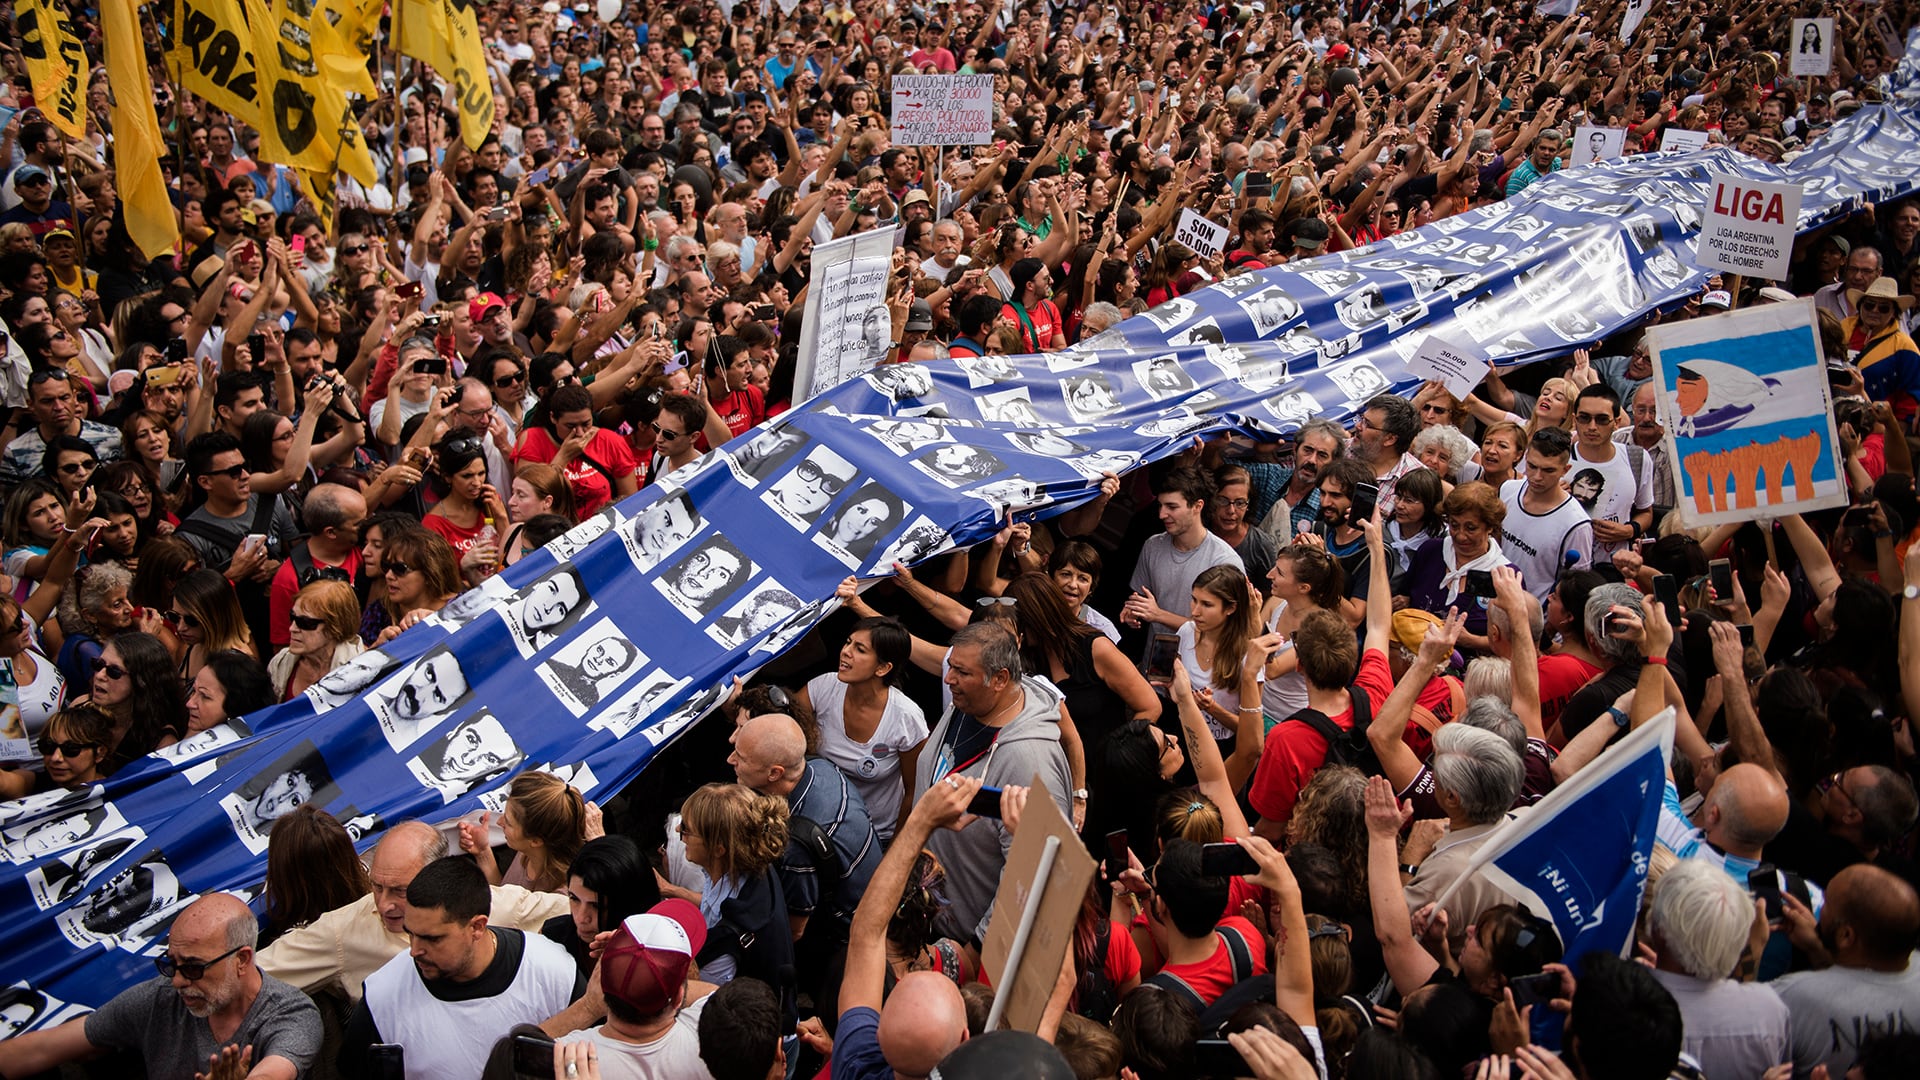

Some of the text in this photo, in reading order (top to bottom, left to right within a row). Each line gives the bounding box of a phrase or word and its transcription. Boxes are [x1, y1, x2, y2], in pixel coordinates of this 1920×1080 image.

[444, 5, 467, 38] OPULAR
[913, 89, 930, 99] POR
[931, 89, 946, 99] LOS
[924, 100, 963, 110] POR LOS
[897, 110, 933, 122] PRESOS
[904, 122, 989, 133] POR LOS ASESINADOS
[902, 133, 975, 144] EN DEMOCRACIA
[1713, 183, 1784, 225] LIGA
[1190, 219, 1216, 242] SON
[1717, 227, 1775, 246] LIGA ARGENTINA
[1709, 238, 1780, 259] POR LOS DERECHOS
[1718, 252, 1764, 269] DEL HOMBRE
[1440, 350, 1467, 367] 30.000
[1430, 364, 1454, 378] Presente
[1631, 850, 1649, 875] de
